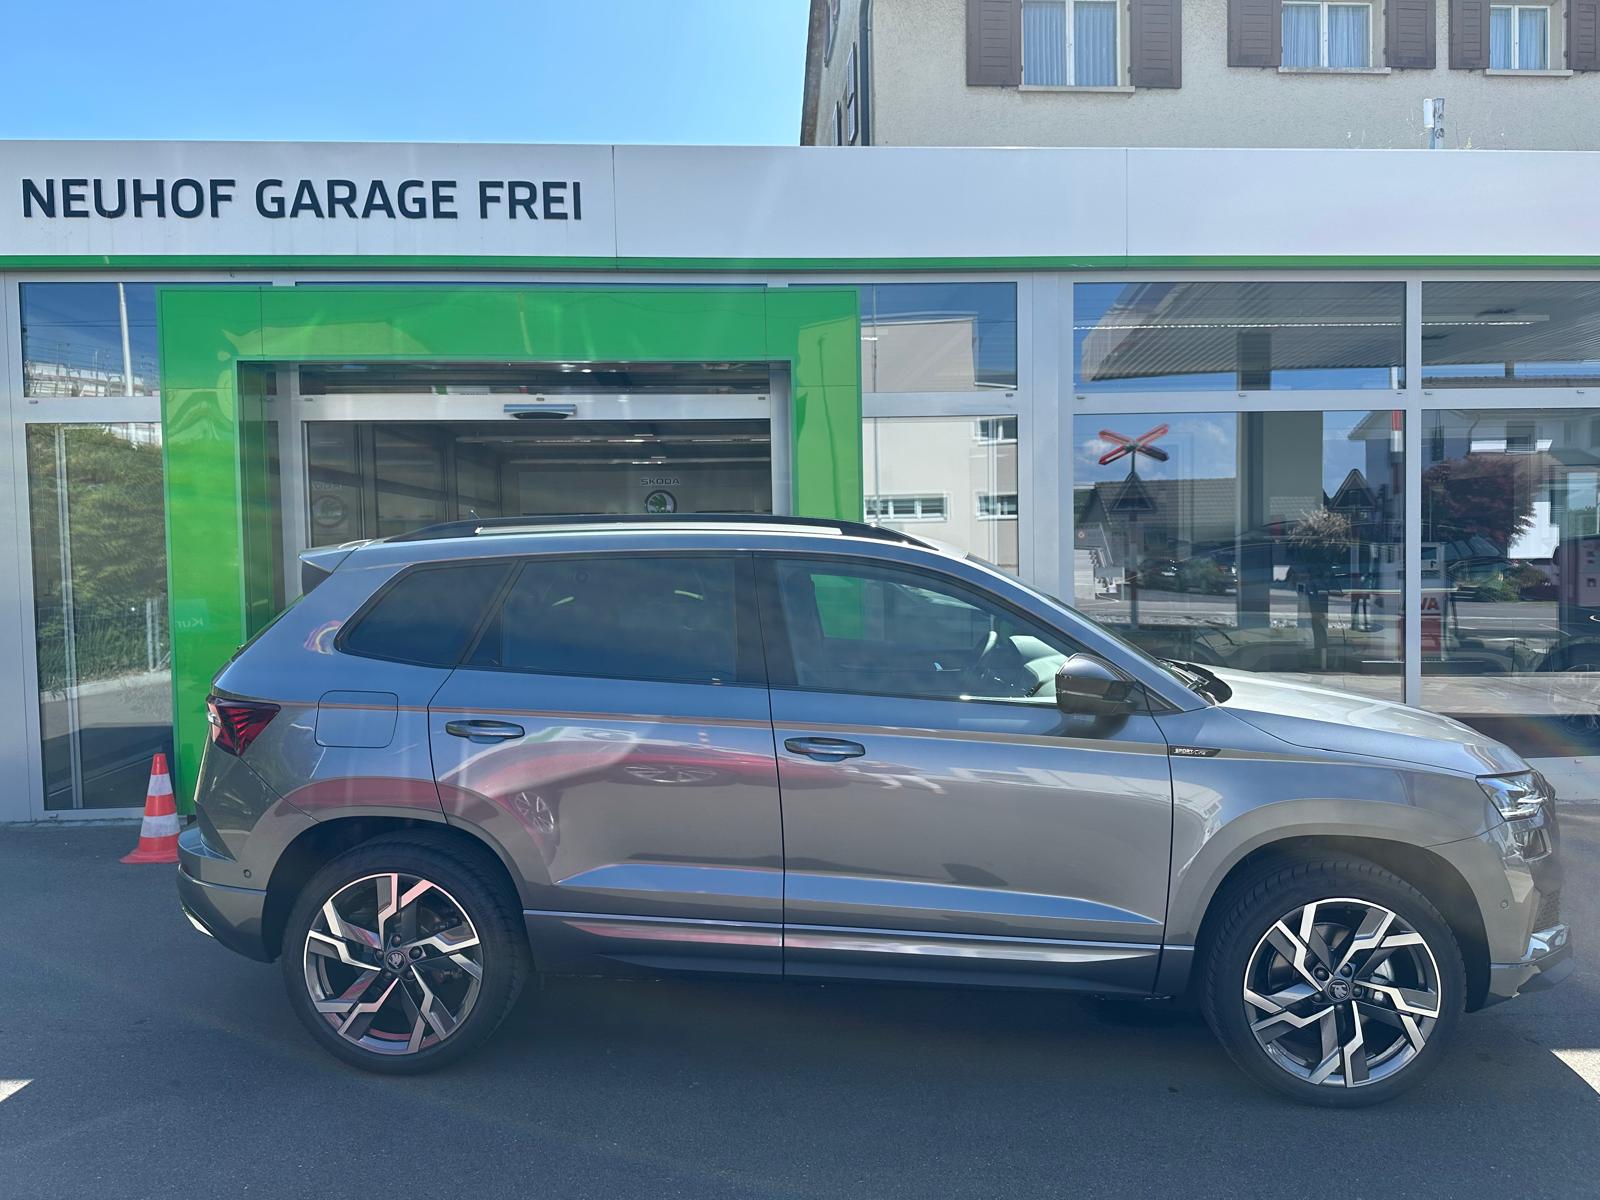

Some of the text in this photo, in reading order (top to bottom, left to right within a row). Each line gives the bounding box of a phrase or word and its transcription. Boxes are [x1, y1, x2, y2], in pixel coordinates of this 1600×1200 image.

[22, 178, 582, 220] NEUHOF GARAGE FREI
